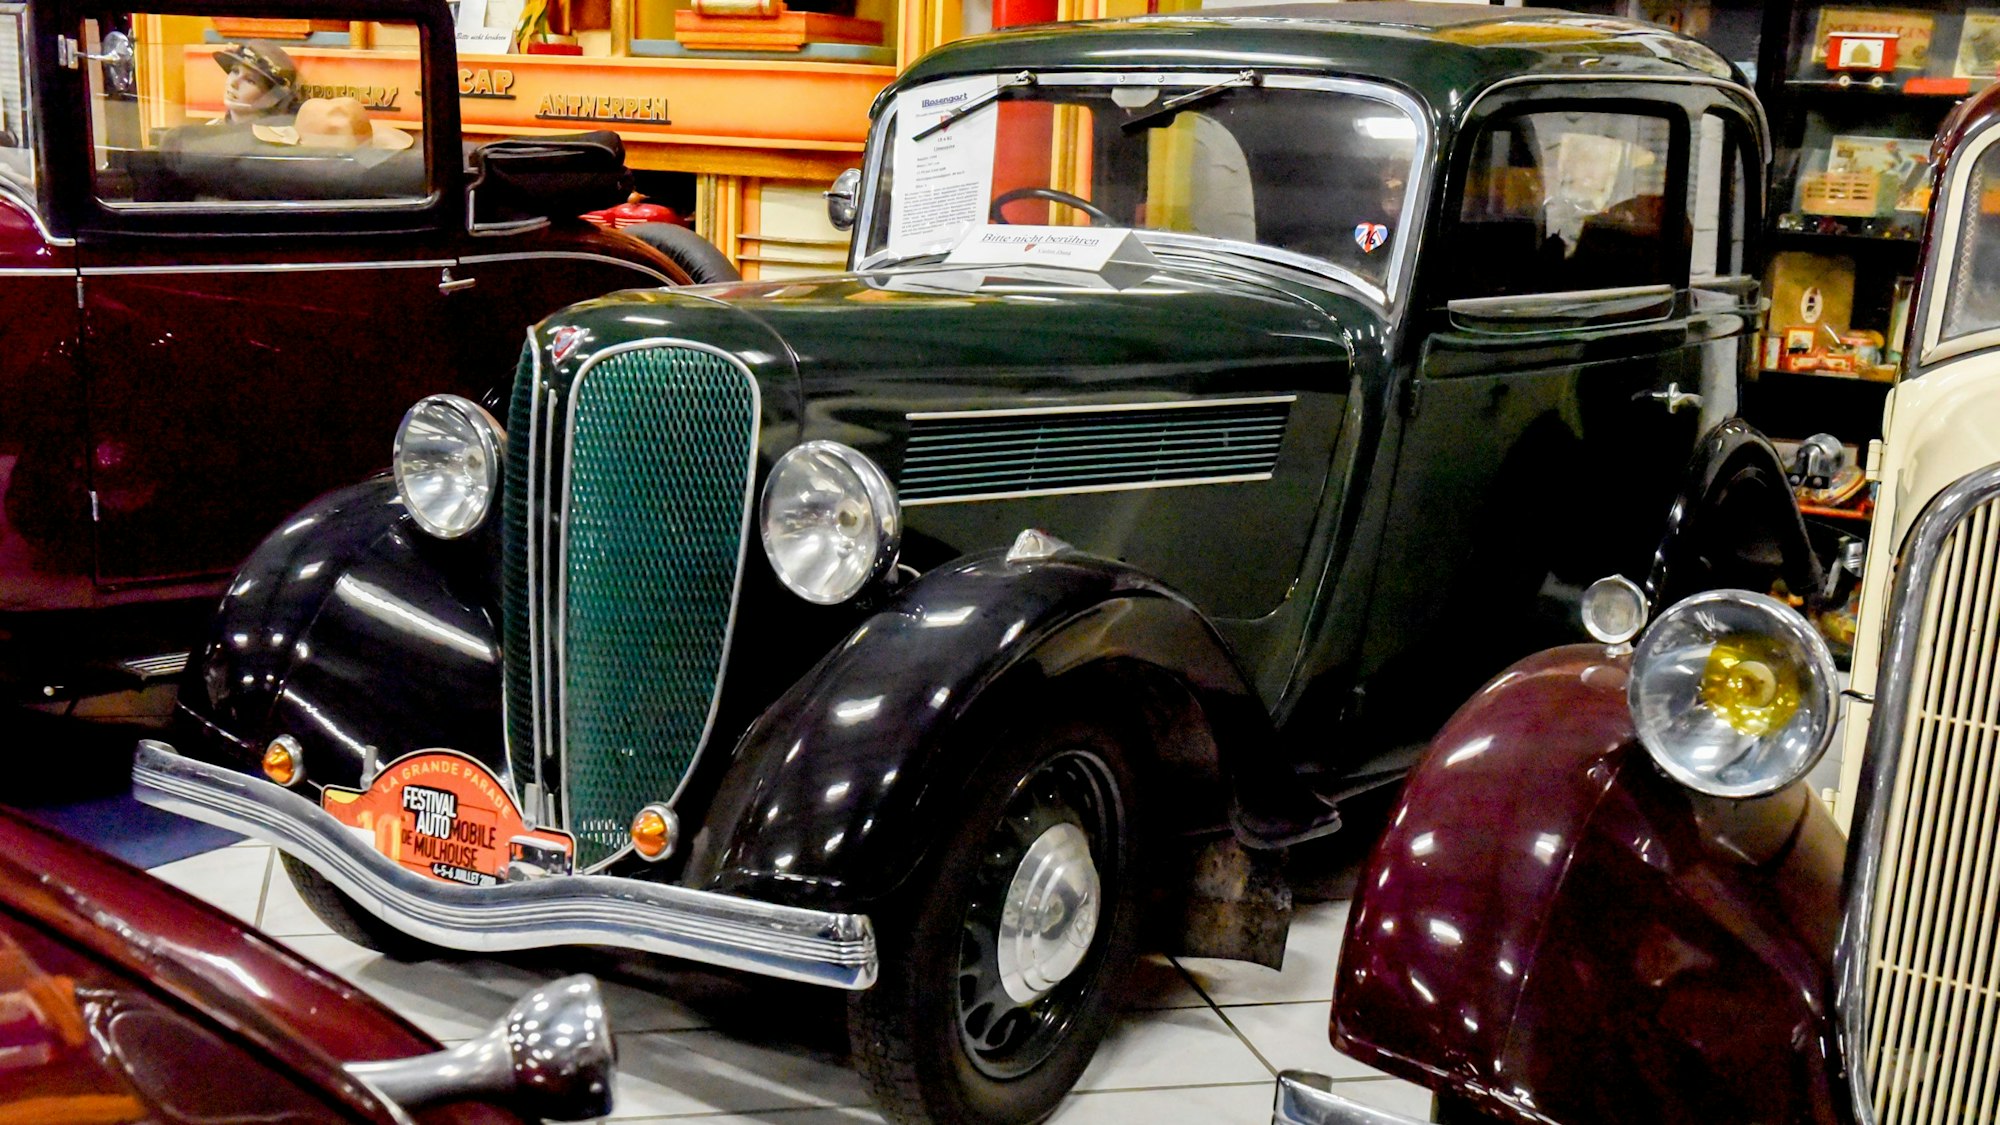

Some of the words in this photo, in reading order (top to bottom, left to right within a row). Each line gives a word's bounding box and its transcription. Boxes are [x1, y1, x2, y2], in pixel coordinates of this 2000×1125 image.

[538, 95, 668, 121] ANTWERPEN
[982, 232, 1011, 243] Bitte
[1013, 234, 1043, 244] nicht
[1044, 234, 1100, 247] berühren
[380, 775, 399, 793] LA
[401, 760, 460, 780] GRANDE
[463, 767, 513, 819] PARADE
[402, 785, 457, 818] FESTIVAL
[401, 828, 413, 846] DE
[414, 834, 478, 871] MULHOUSE
